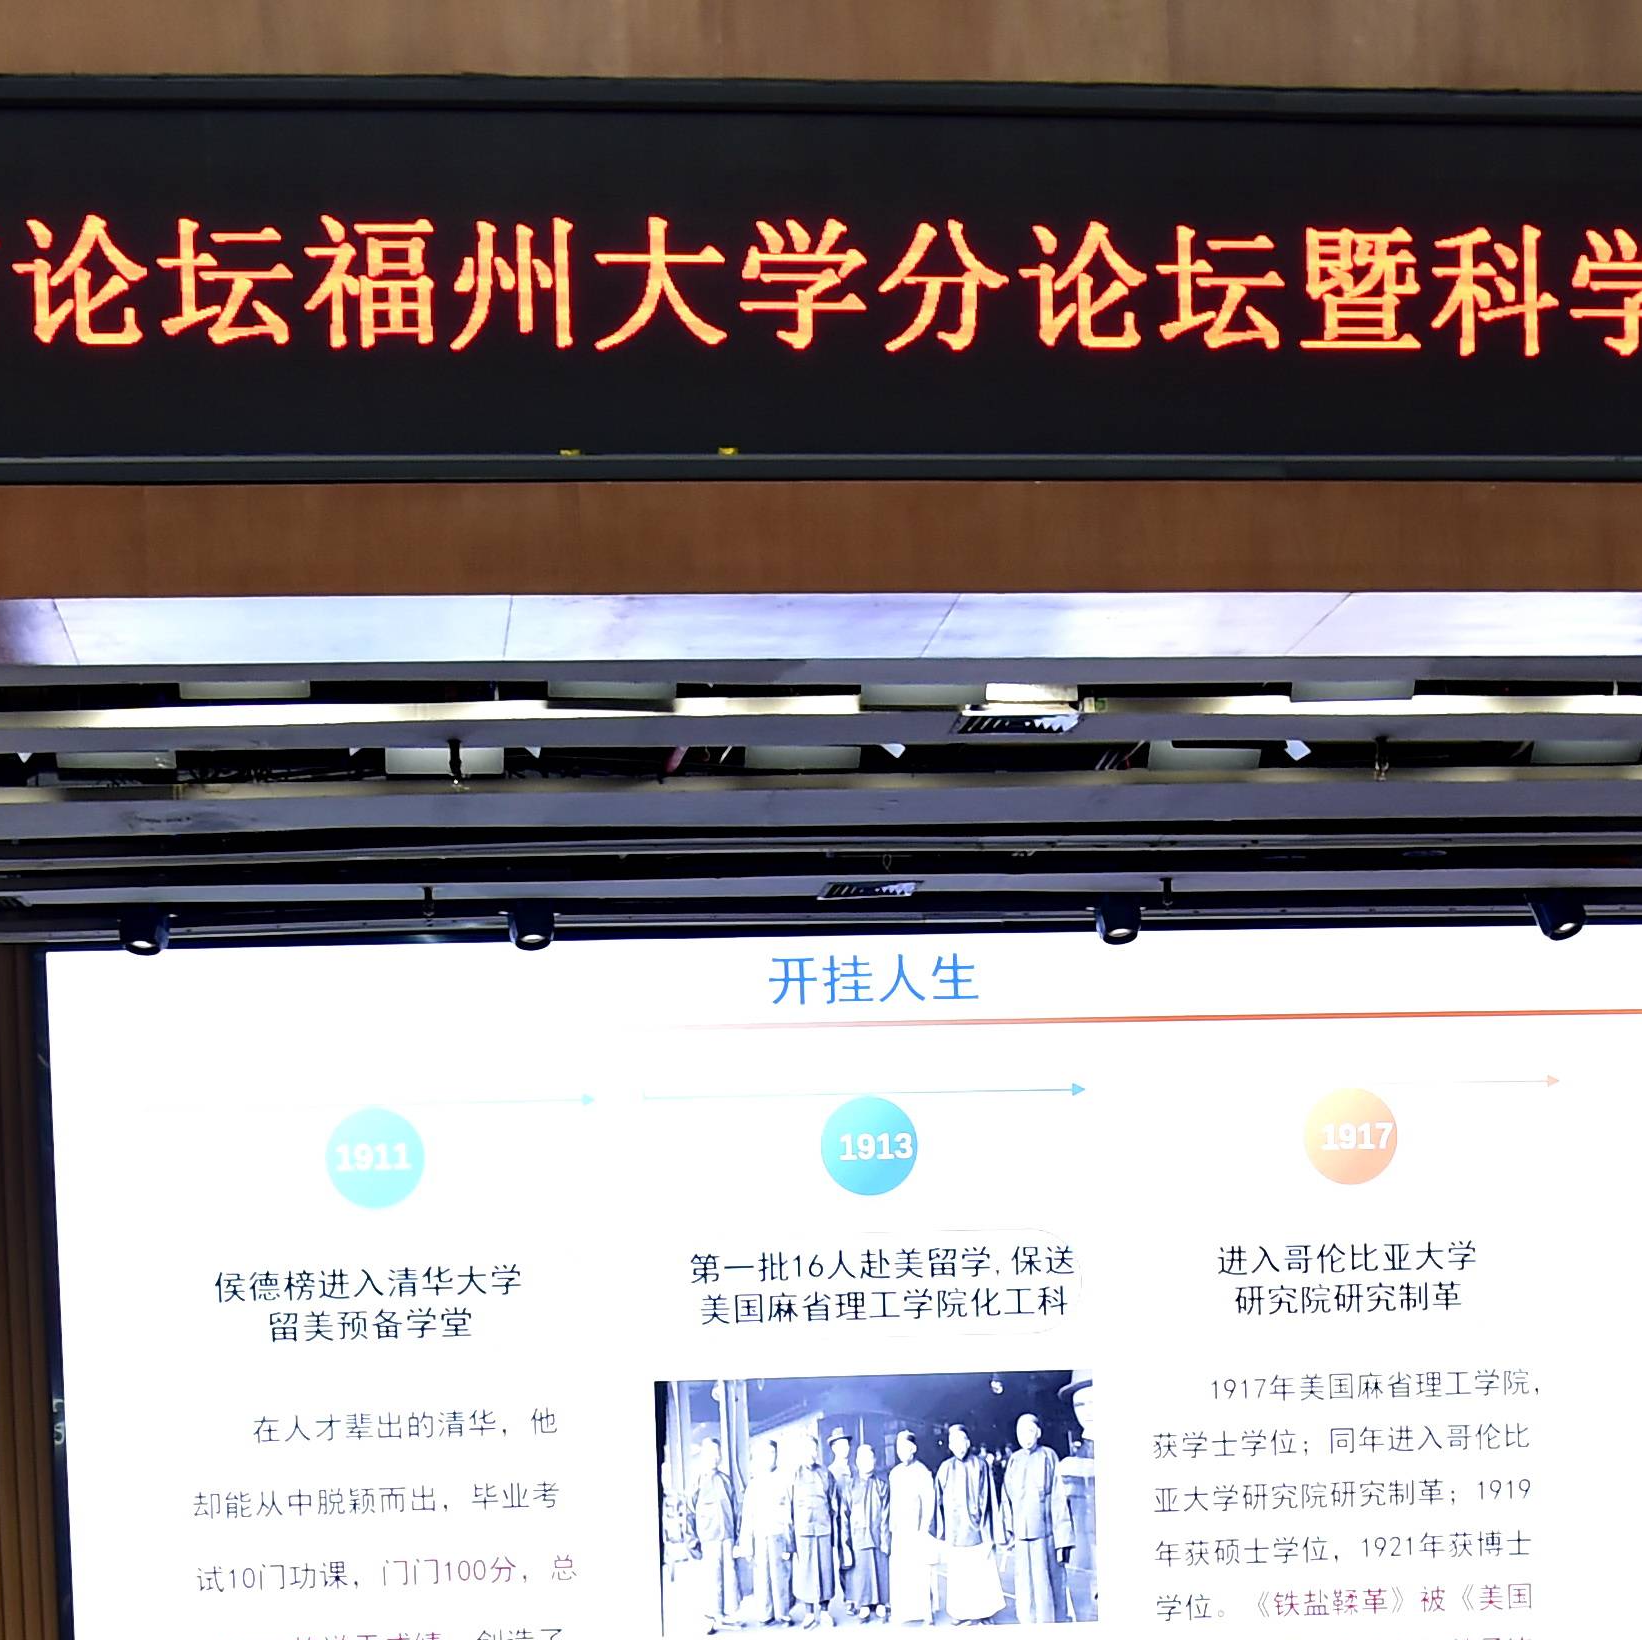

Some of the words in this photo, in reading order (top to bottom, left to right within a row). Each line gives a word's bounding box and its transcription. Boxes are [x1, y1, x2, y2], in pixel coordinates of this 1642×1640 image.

[769, 953, 979, 1005] 开挂人生
[838, 1132, 914, 1161] 1913
[1321, 1122, 1395, 1152] 1917
[335, 1142, 411, 1173] 1911
[1218, 1241, 1477, 1276] 进入哥伦比亚大学
[215, 1264, 522, 1303] 侯德榜进入清华大学
[1234, 1281, 1463, 1318] 研究院研究制革
[700, 1286, 1068, 1326] 美国麻省理工学院化工科
[269, 1308, 473, 1343] 留美预备学堂
